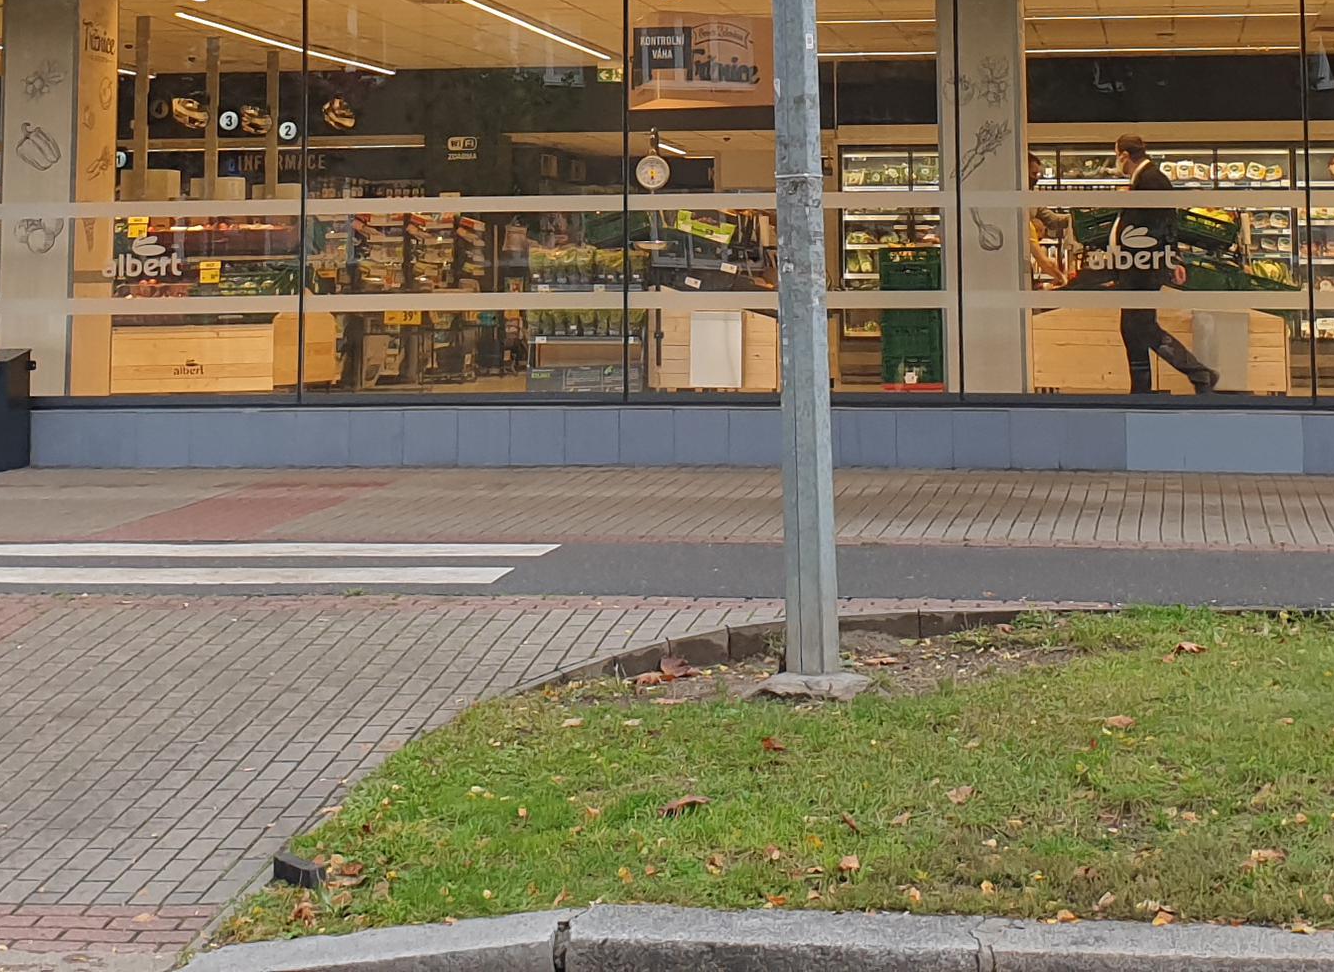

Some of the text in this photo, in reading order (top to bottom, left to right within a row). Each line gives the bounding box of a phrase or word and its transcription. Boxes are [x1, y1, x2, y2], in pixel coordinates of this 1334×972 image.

[225, 115, 233, 127] 3
[285, 125, 291, 137] 2
[1087, 244, 1178, 270] albert
[102, 252, 182, 277] albert
[173, 364, 204, 376] albert
